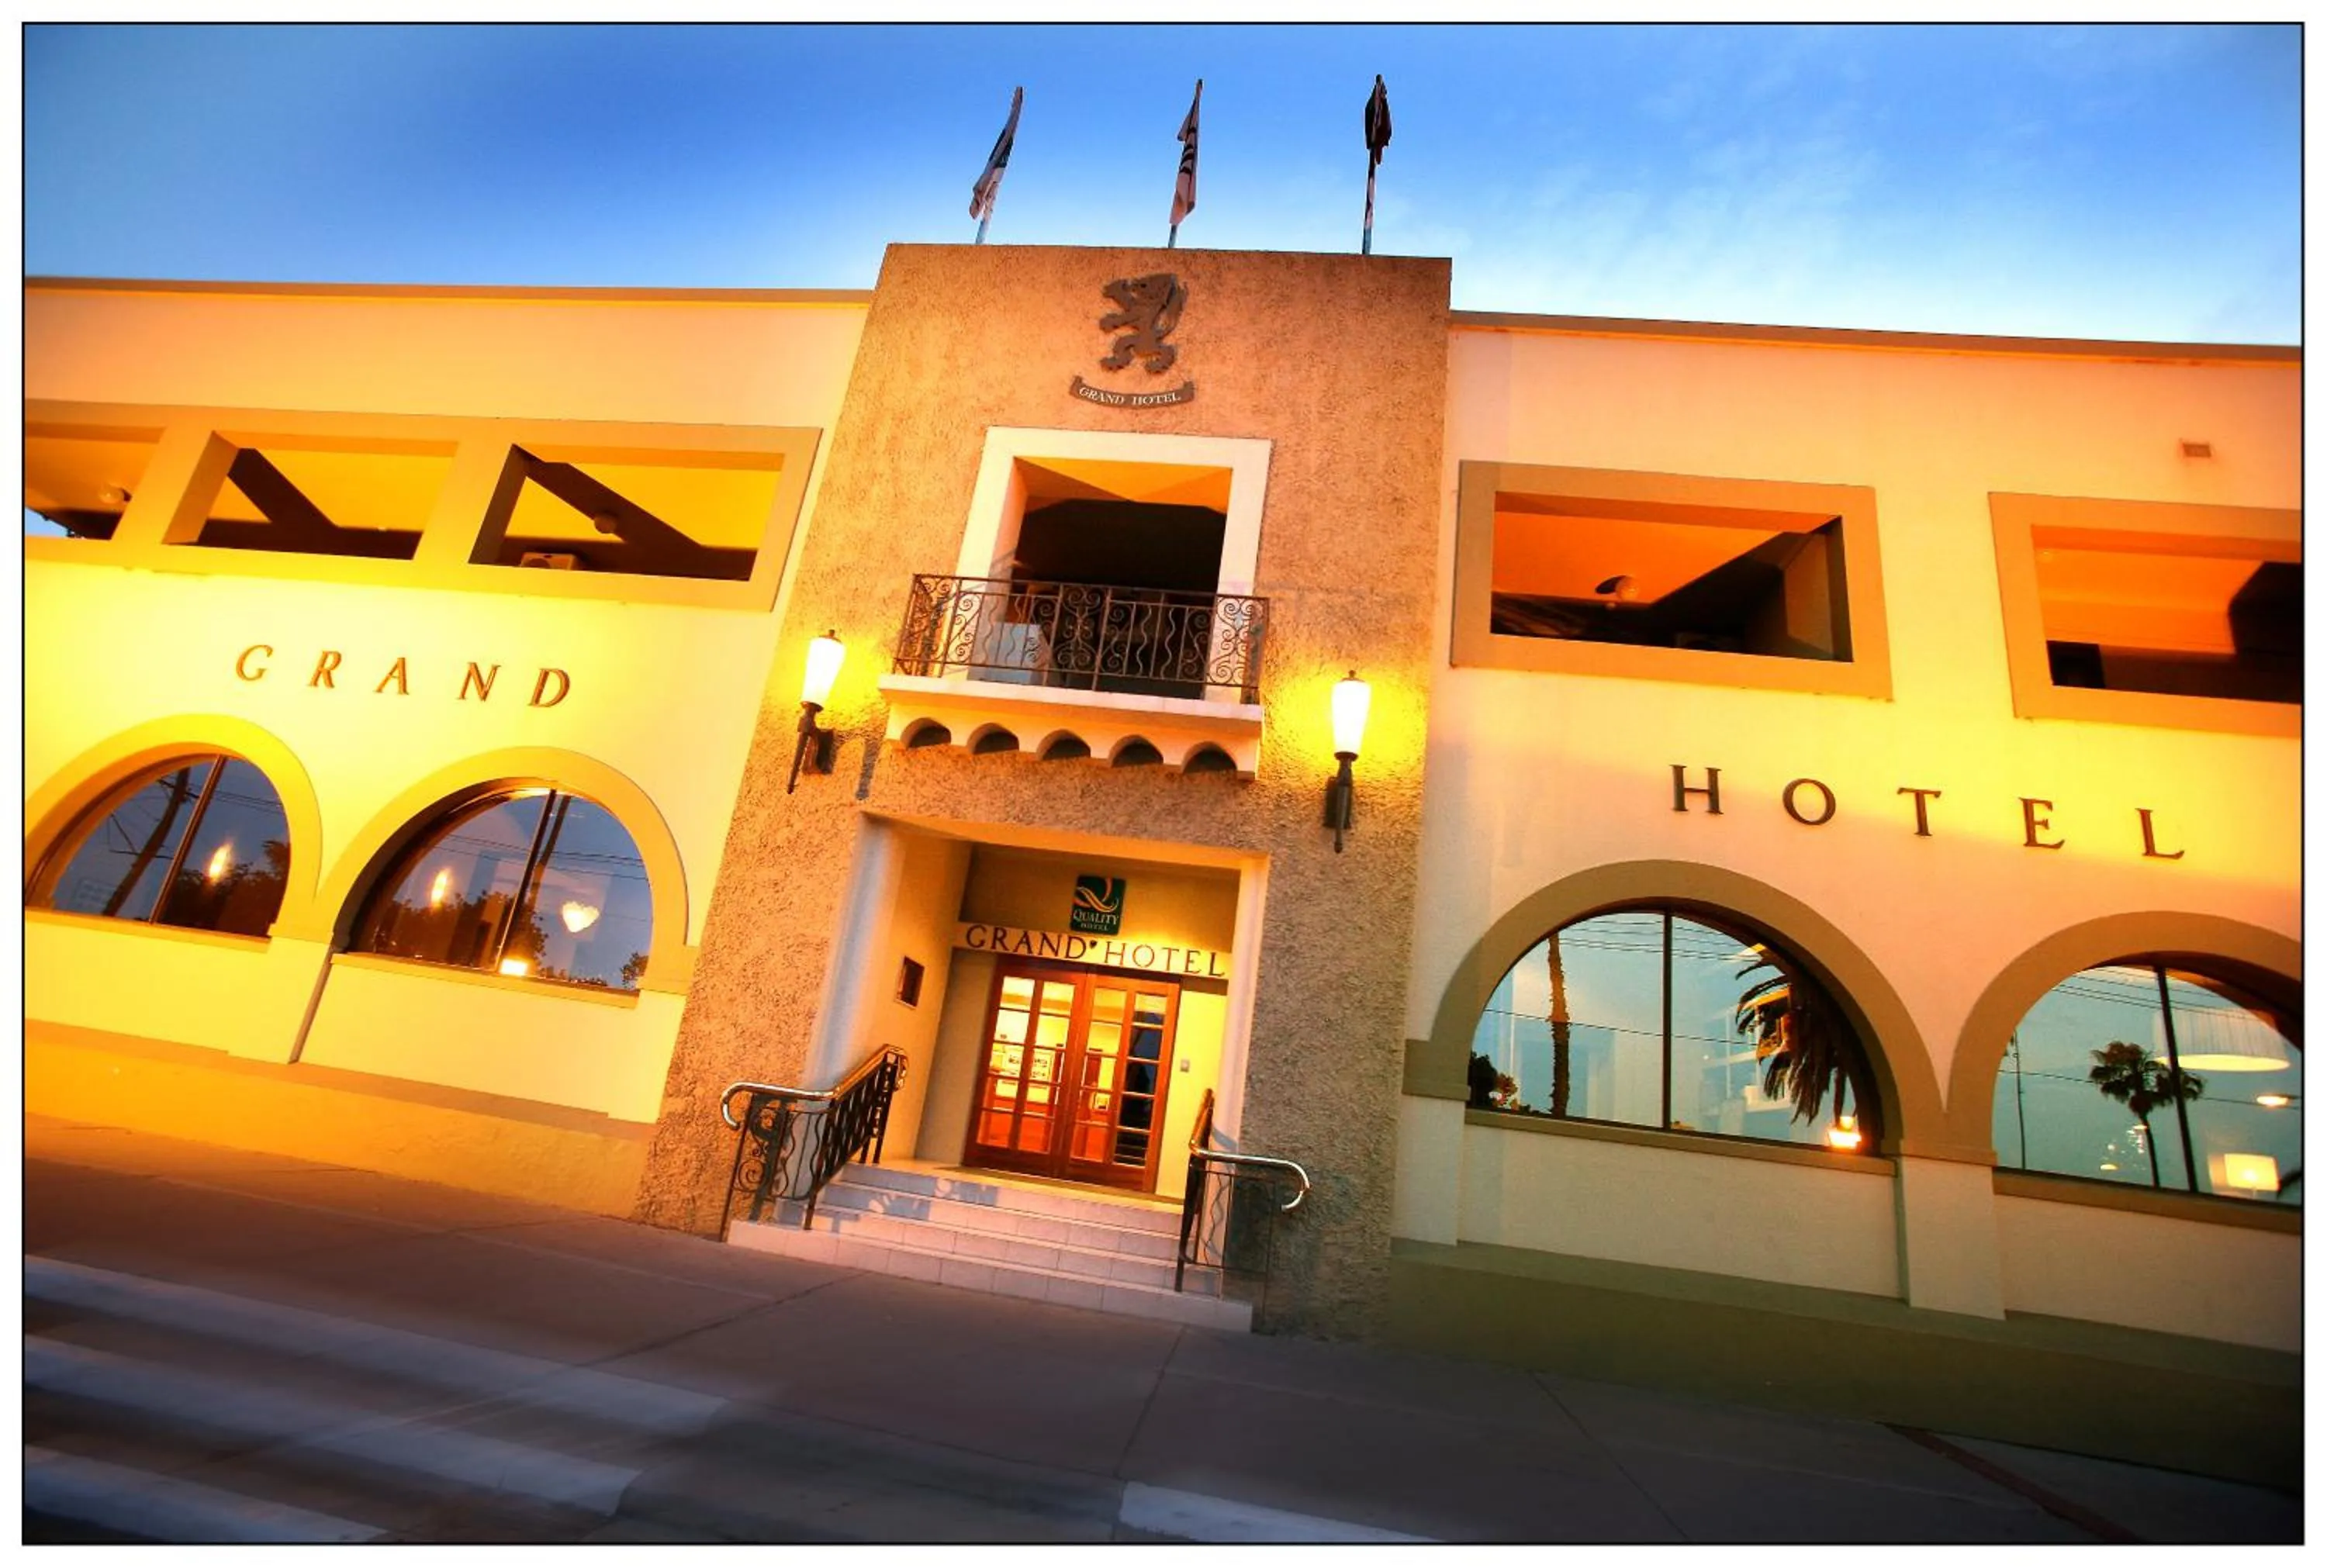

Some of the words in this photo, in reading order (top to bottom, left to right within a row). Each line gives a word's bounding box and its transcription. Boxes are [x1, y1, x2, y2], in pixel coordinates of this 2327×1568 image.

[1079, 387, 1125, 404] GRAND
[1132, 392, 1181, 405] HOTEL
[236, 644, 571, 708] GRAND
[1669, 765, 2185, 860] HOTEL
[1073, 909, 1119, 925] QUALITY
[966, 924, 1087, 959] GRAND
[1104, 941, 1226, 977] HOTEL
